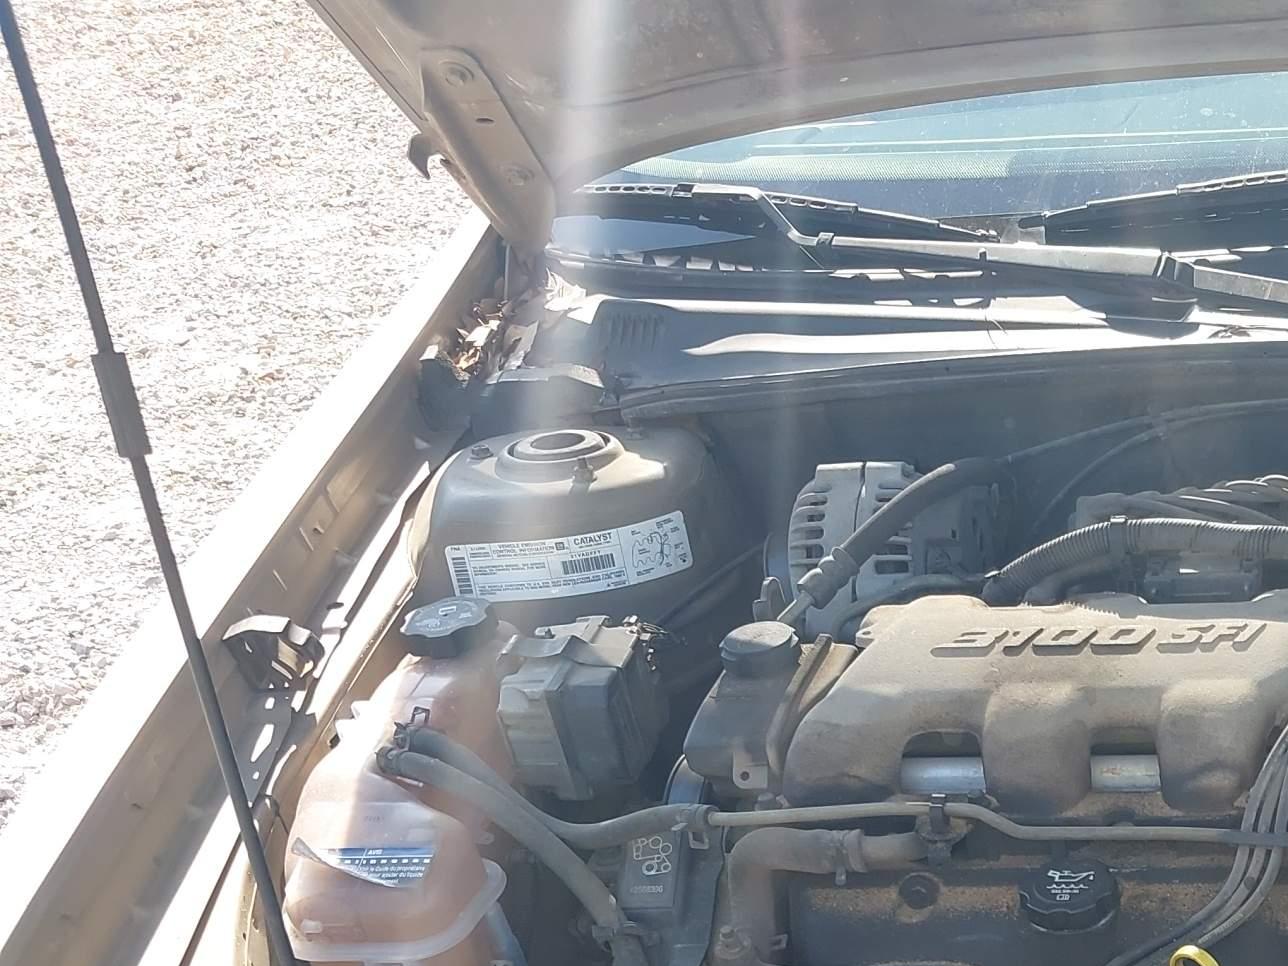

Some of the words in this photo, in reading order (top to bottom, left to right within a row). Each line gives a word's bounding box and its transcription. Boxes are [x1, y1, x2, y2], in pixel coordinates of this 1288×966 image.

[573, 532, 612, 546] CATALYST
[931, 628, 1156, 657] 3100
[1156, 623, 1267, 654] SFI
